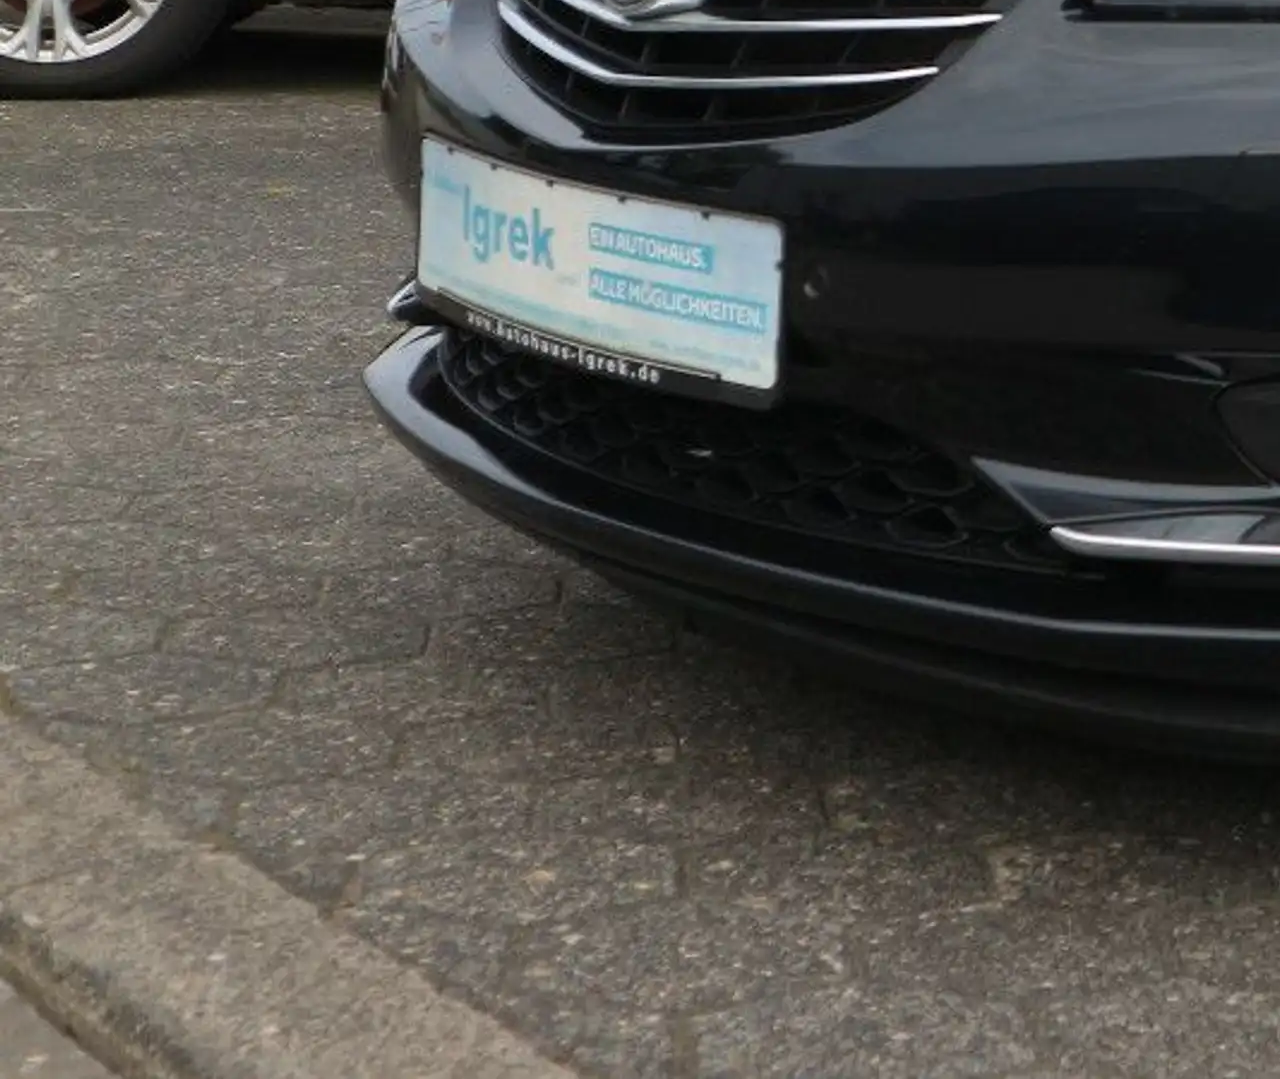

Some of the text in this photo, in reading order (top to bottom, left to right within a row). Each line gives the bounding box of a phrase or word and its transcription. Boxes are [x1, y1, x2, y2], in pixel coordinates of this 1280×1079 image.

[463, 184, 555, 271] Igrek
[590, 226, 708, 269] EIN AUTOHAUS.
[590, 275, 626, 299] ALLE
